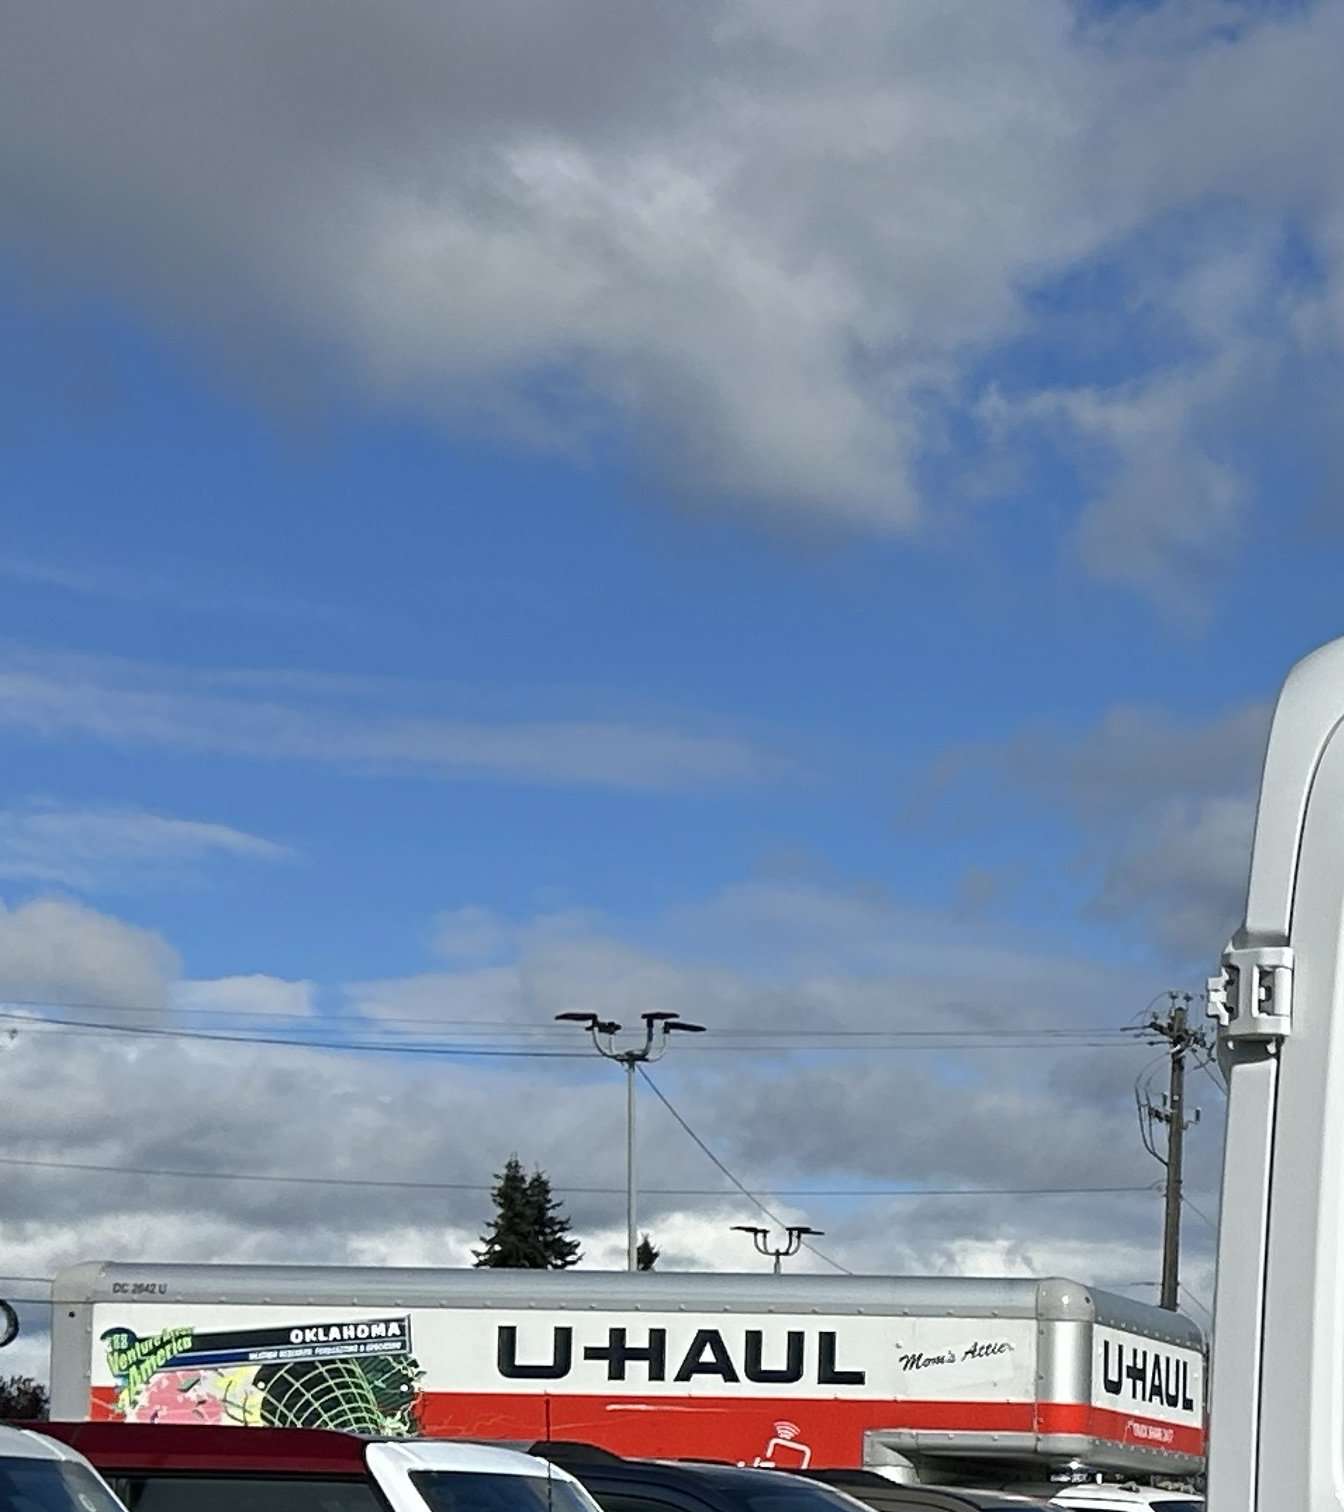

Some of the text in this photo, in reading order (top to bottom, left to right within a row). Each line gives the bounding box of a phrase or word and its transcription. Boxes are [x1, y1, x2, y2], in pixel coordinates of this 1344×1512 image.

[289, 1321, 401, 1344] OKLAHOMA
[497, 1326, 866, 1385] U-HAUL
[1103, 1339, 1194, 1412] U-HAUL
